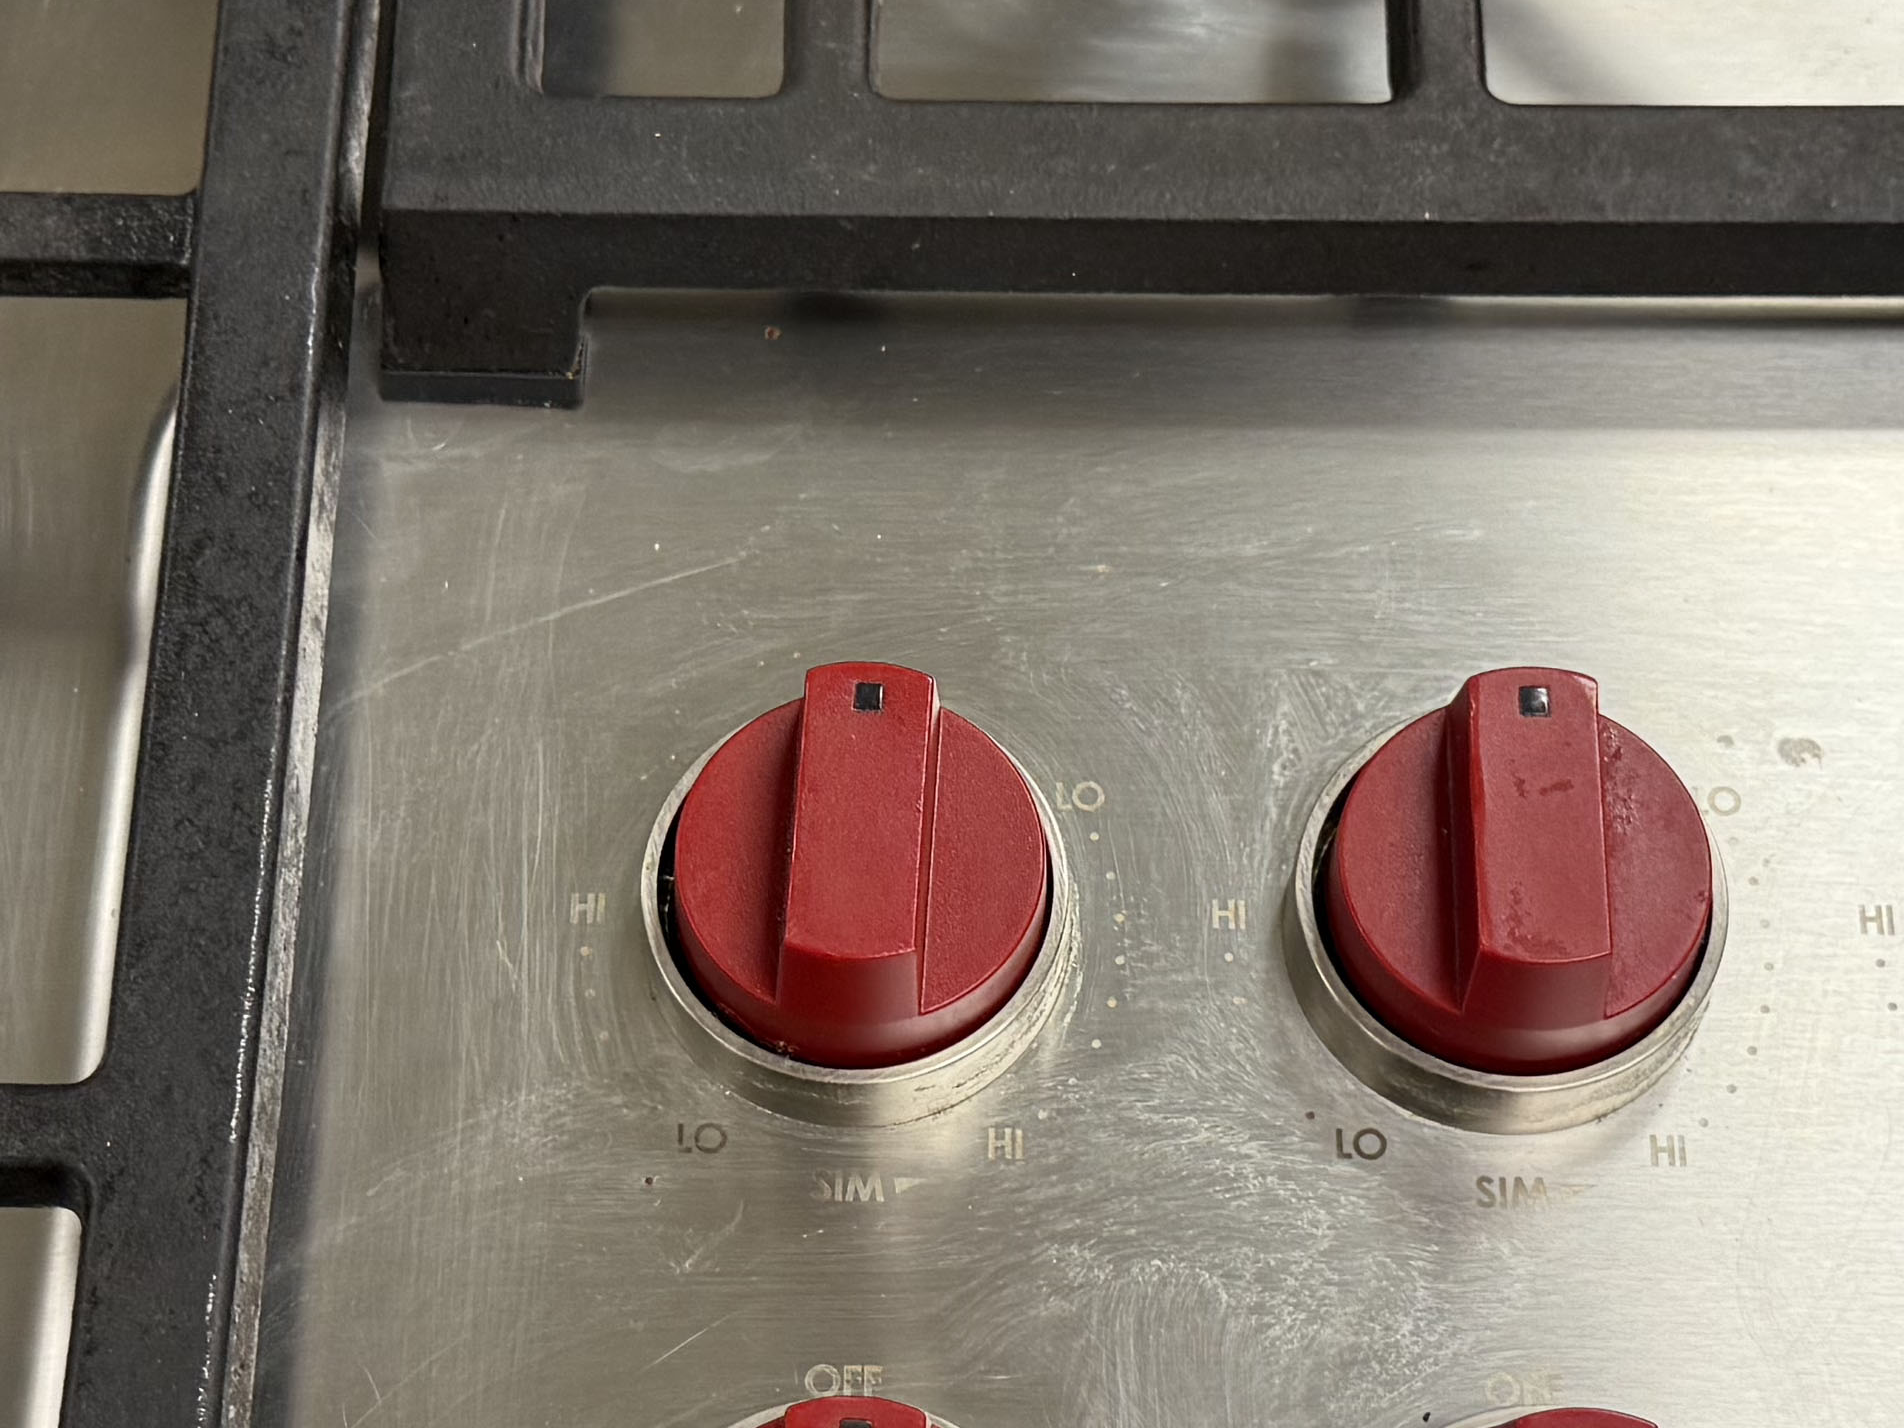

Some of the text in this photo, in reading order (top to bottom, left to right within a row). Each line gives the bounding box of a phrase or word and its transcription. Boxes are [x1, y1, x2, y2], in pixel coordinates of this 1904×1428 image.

[1056, 780, 1105, 811] LO
[570, 892, 606, 925] HI
[1212, 900, 1247, 930] HI
[1859, 905, 1895, 936] HI
[677, 1122, 728, 1155] LO
[988, 1127, 1025, 1160] HI
[1336, 1127, 1388, 1160] LO
[1650, 1134, 1687, 1167] HI
[810, 1171, 885, 1203] SIM
[1475, 1176, 1549, 1210] SIM
[804, 1364, 883, 1396] OFF
